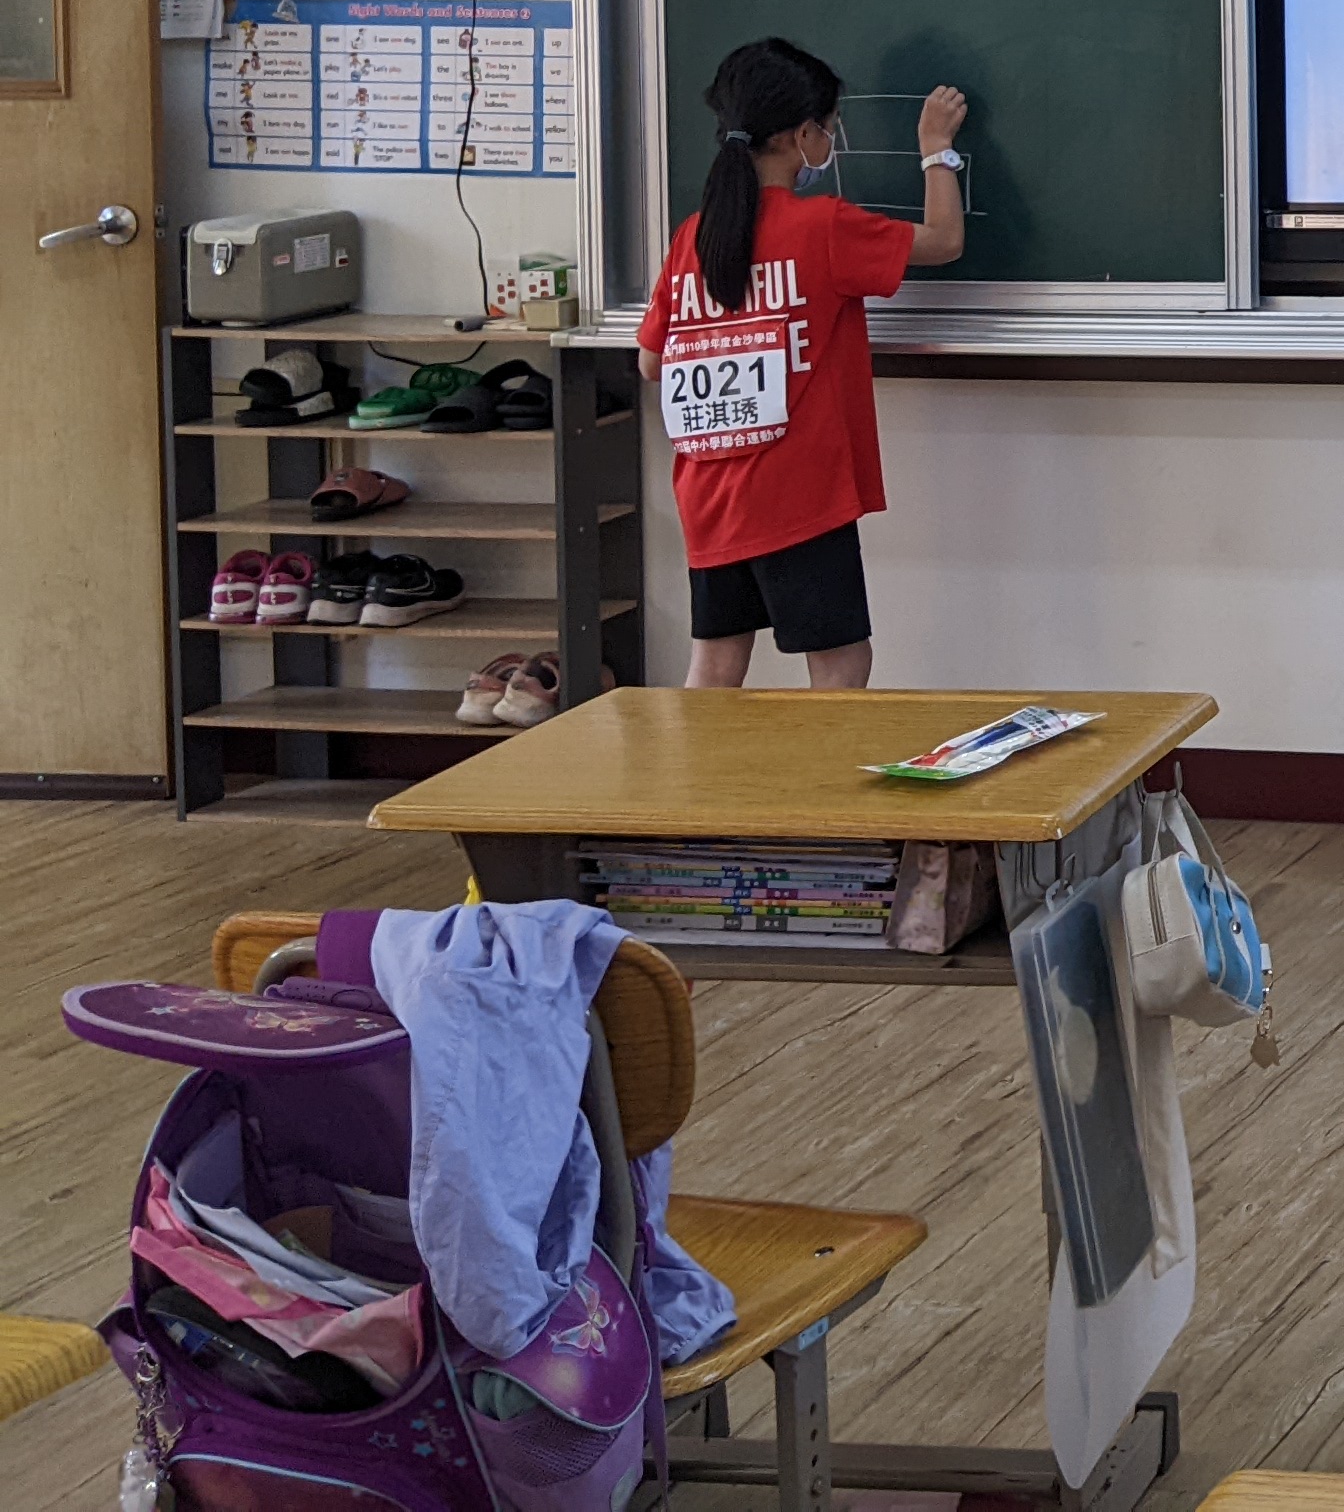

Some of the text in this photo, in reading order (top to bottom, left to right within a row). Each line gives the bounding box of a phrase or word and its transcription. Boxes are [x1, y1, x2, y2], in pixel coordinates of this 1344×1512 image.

[428, 5, 452, 17] and
[545, 125, 567, 135] yellow
[670, 355, 766, 404] 2021
[681, 396, 759, 434] 莊淇琇
